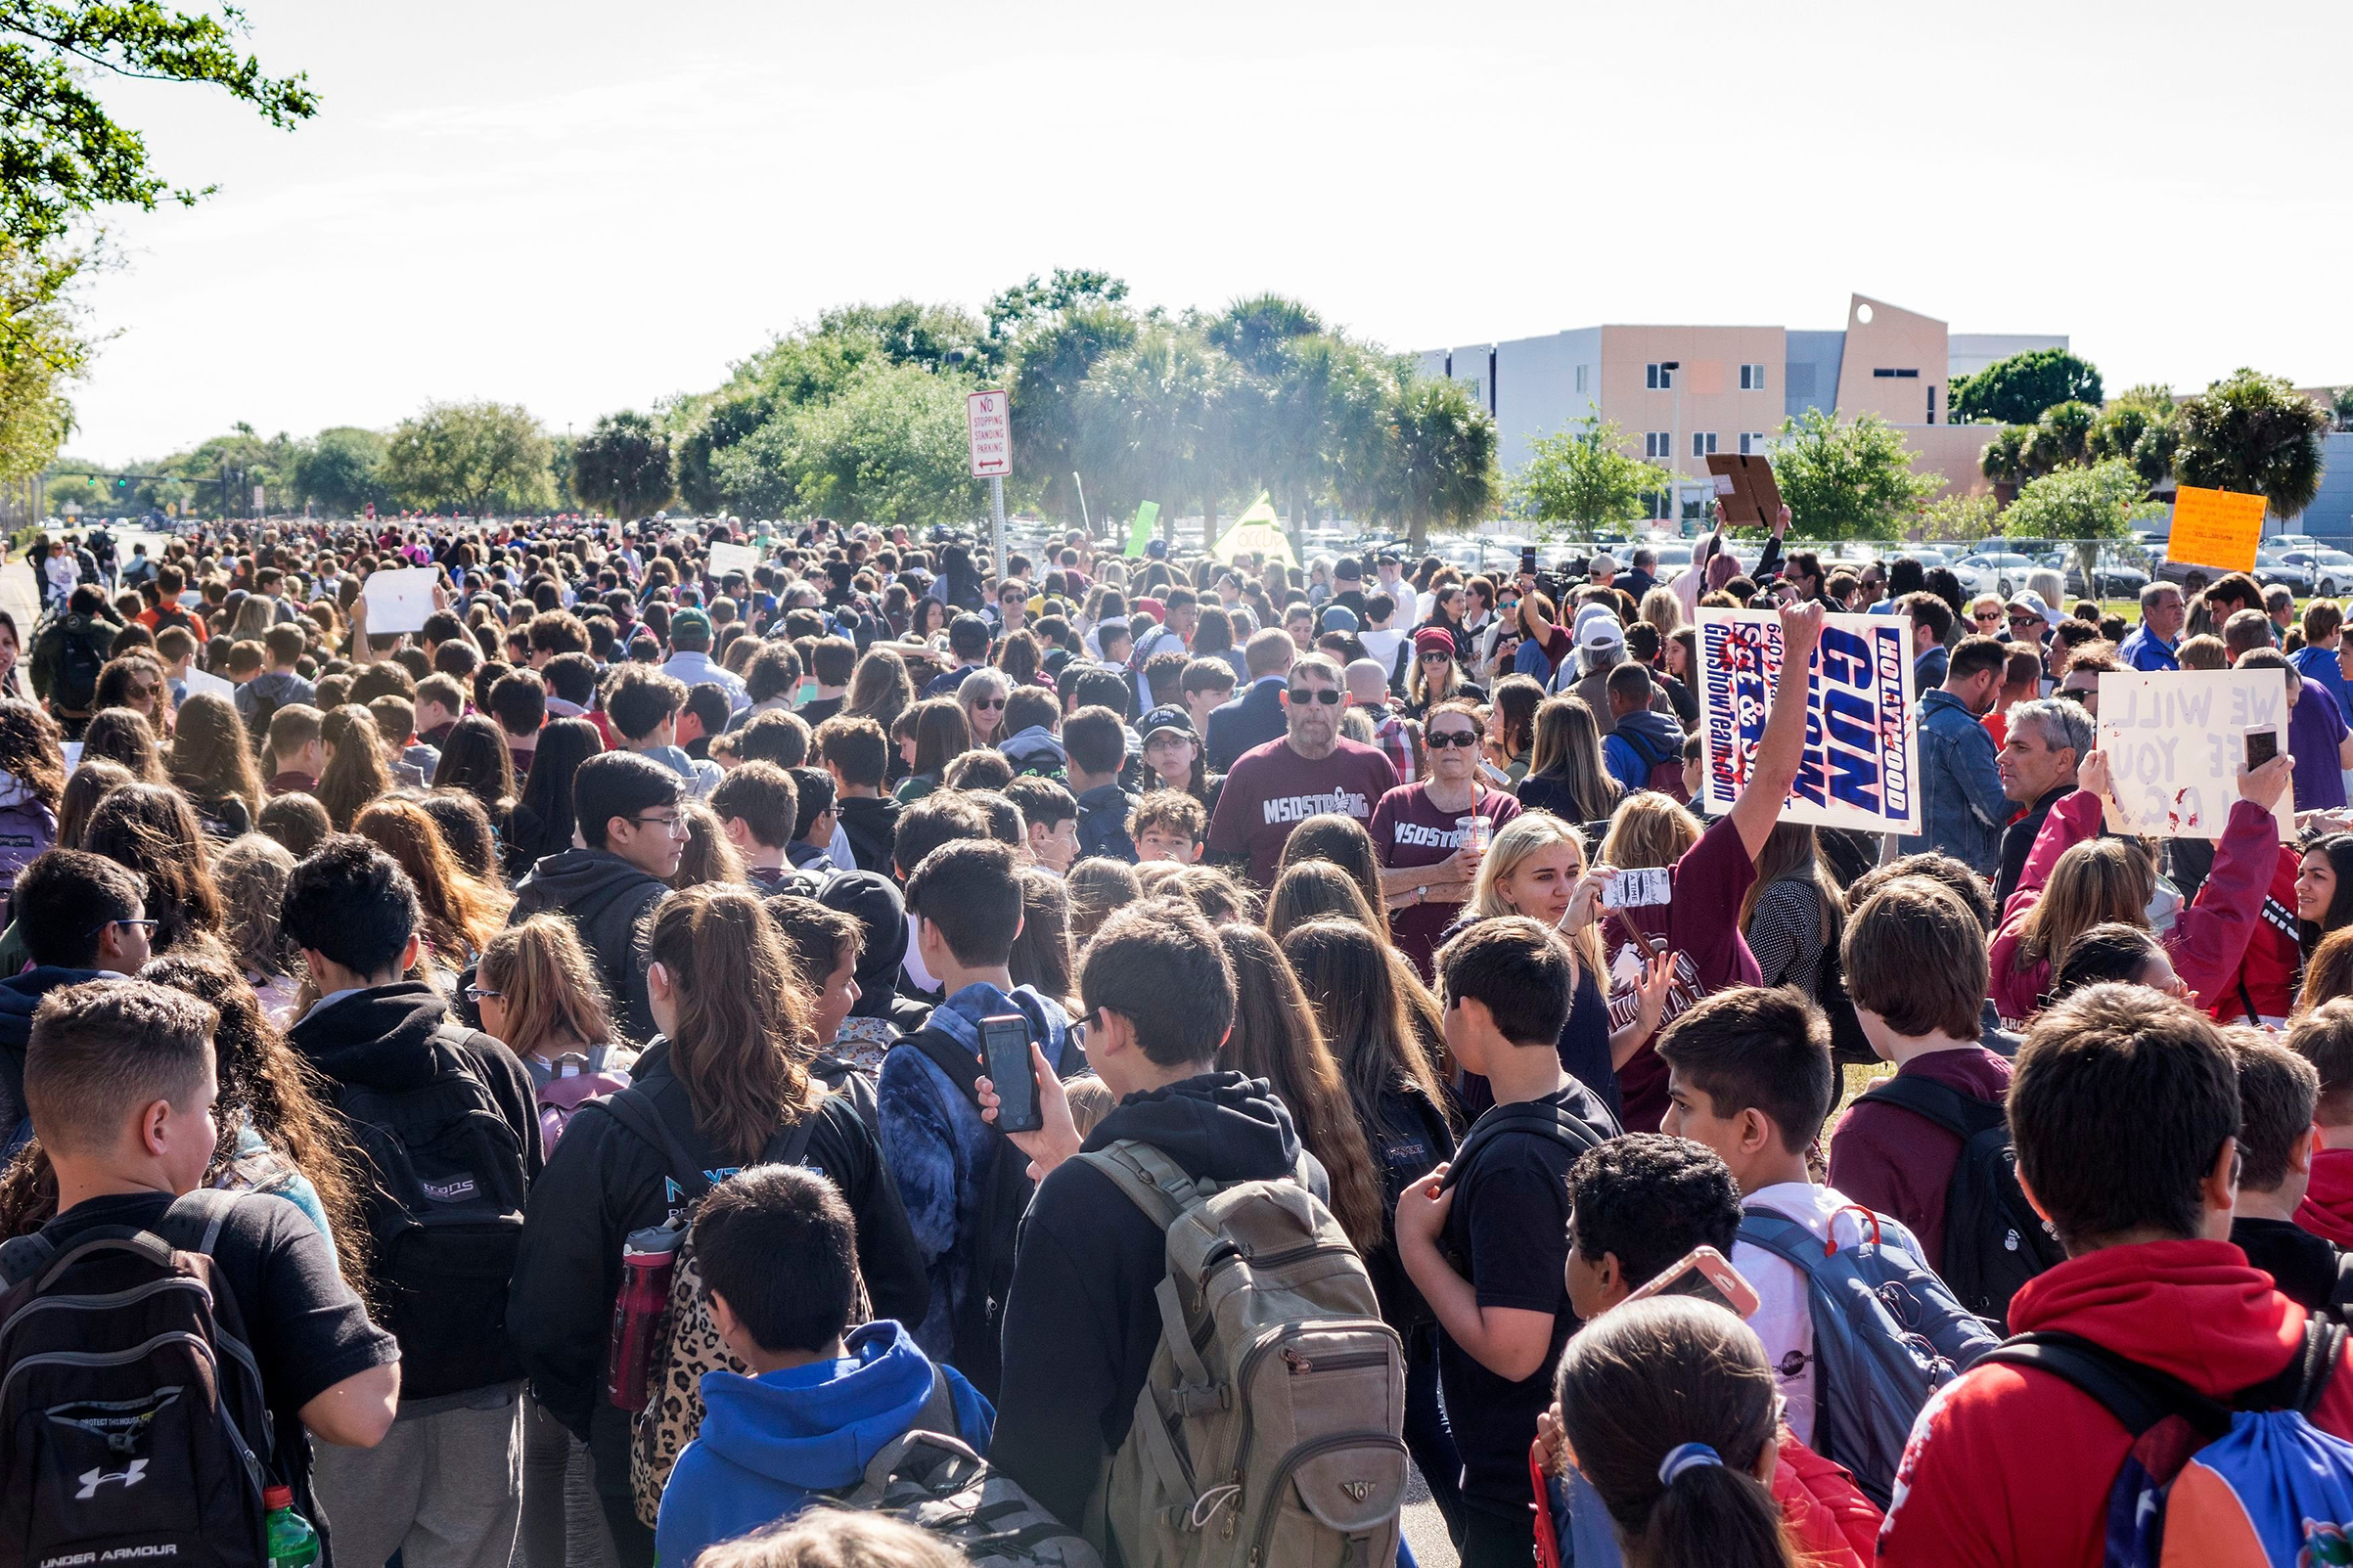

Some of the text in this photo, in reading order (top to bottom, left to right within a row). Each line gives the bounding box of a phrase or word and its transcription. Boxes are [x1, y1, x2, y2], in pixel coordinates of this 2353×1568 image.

[979, 398, 994, 413] NO
[973, 415, 1003, 427] STOPPING
[974, 428, 1004, 441] STANDING
[976, 442, 1003, 454] PARKING
[1734, 624, 1761, 686] Sat
[1767, 623, 1783, 666] 6401
[1703, 623, 1736, 803] GunShowTeam.com
[1739, 694, 1765, 727] &
[1821, 626, 1880, 815] GUN
[1878, 637, 1906, 811] HOLLYWOOD
[424, 1179, 475, 1195] trans
[40, 1544, 178, 1568] UNDER ARMOUR
